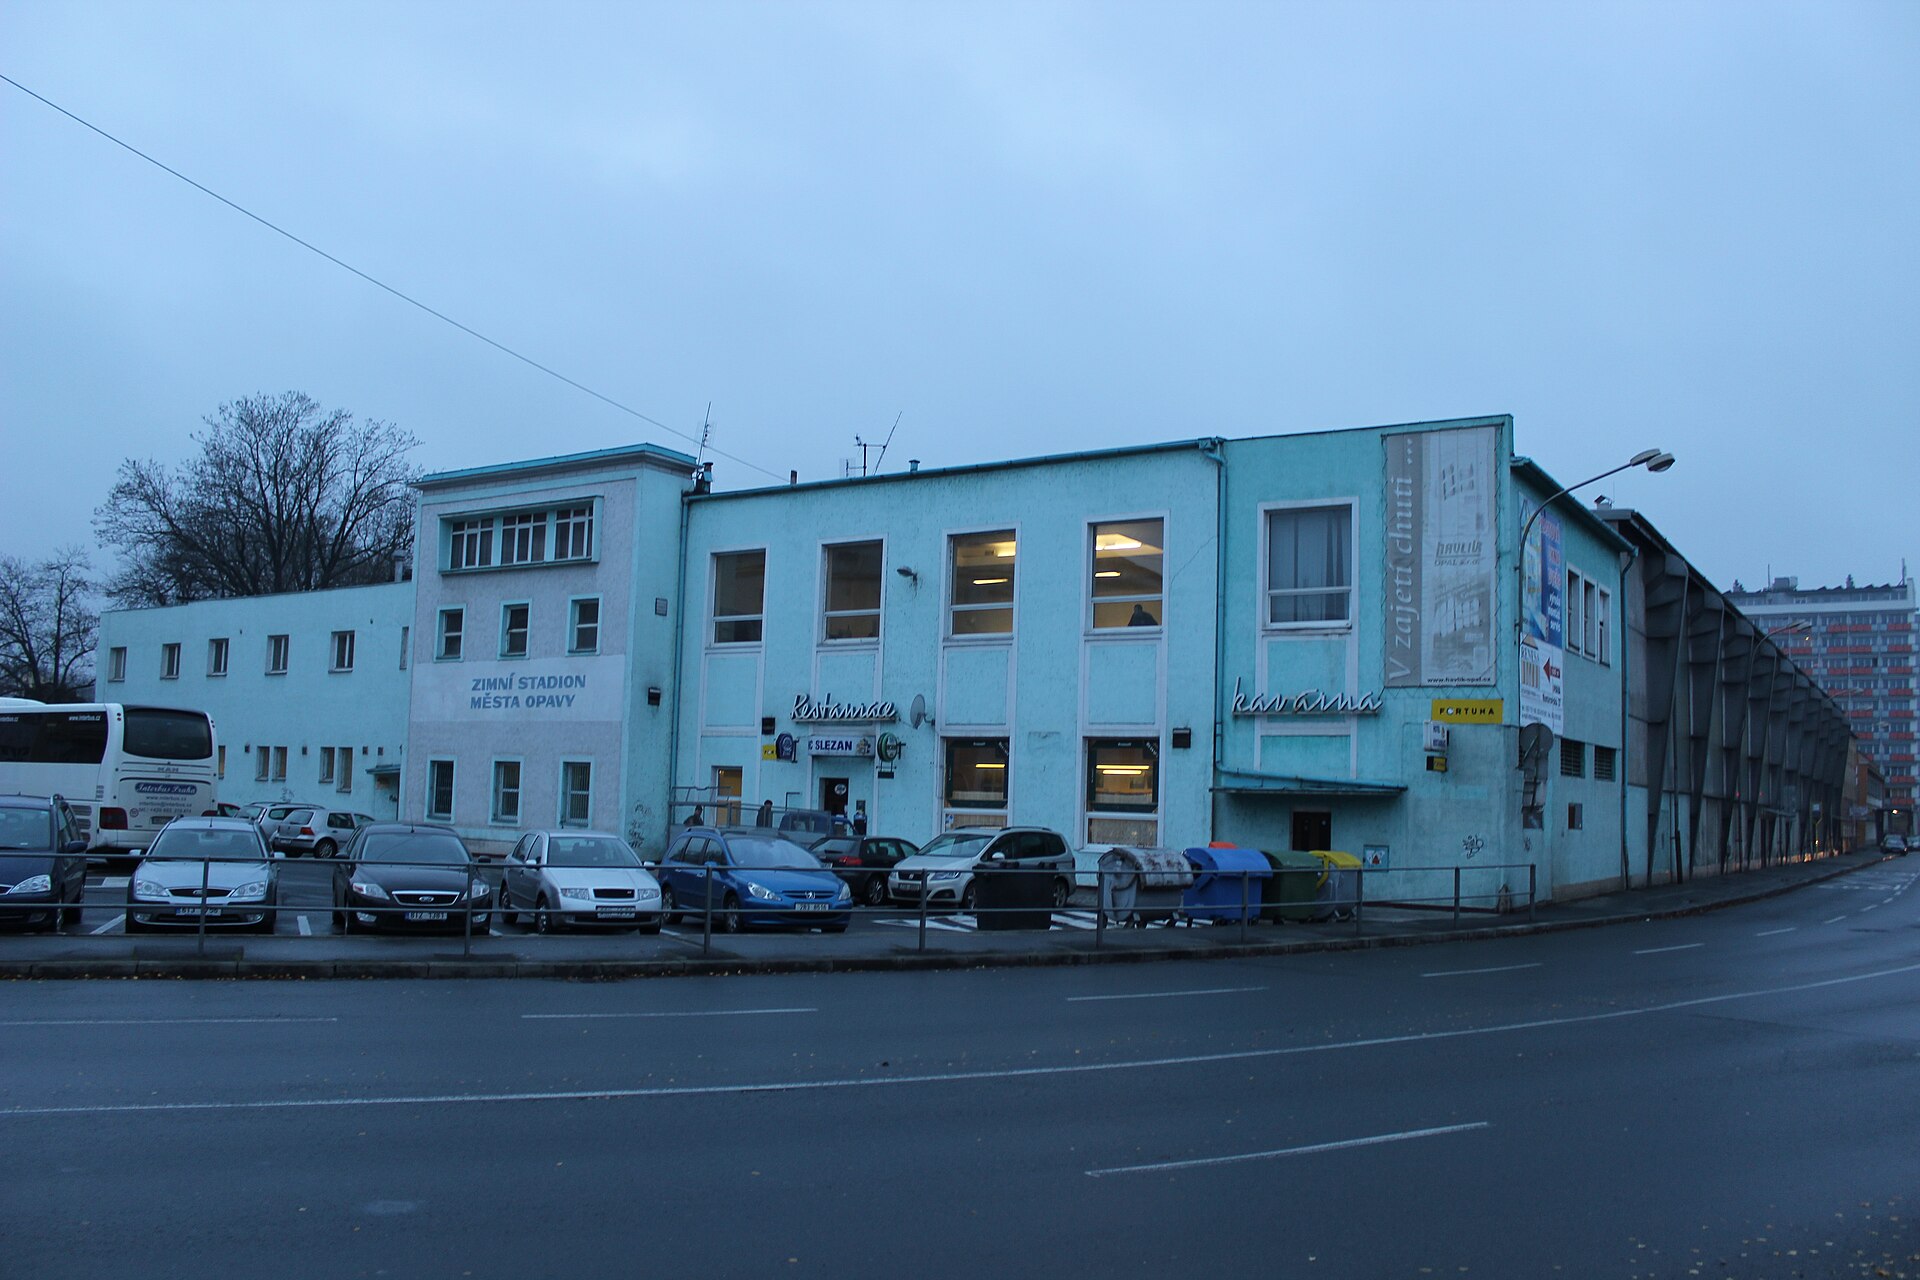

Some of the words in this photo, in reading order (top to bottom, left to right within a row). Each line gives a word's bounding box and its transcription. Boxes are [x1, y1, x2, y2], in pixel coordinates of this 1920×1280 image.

[1388, 475, 1414, 554] chuti
[1388, 561, 1420, 650] zajetí
[1388, 657, 1411, 681] V
[471, 673, 515, 691] ZIMNÍ
[517, 674, 587, 690] STADION
[470, 693, 521, 709] MĚSTA
[525, 694, 576, 708] OPAVY
[1439, 706, 1495, 715] FORTUNA
[815, 740, 853, 751] SLEZAN
